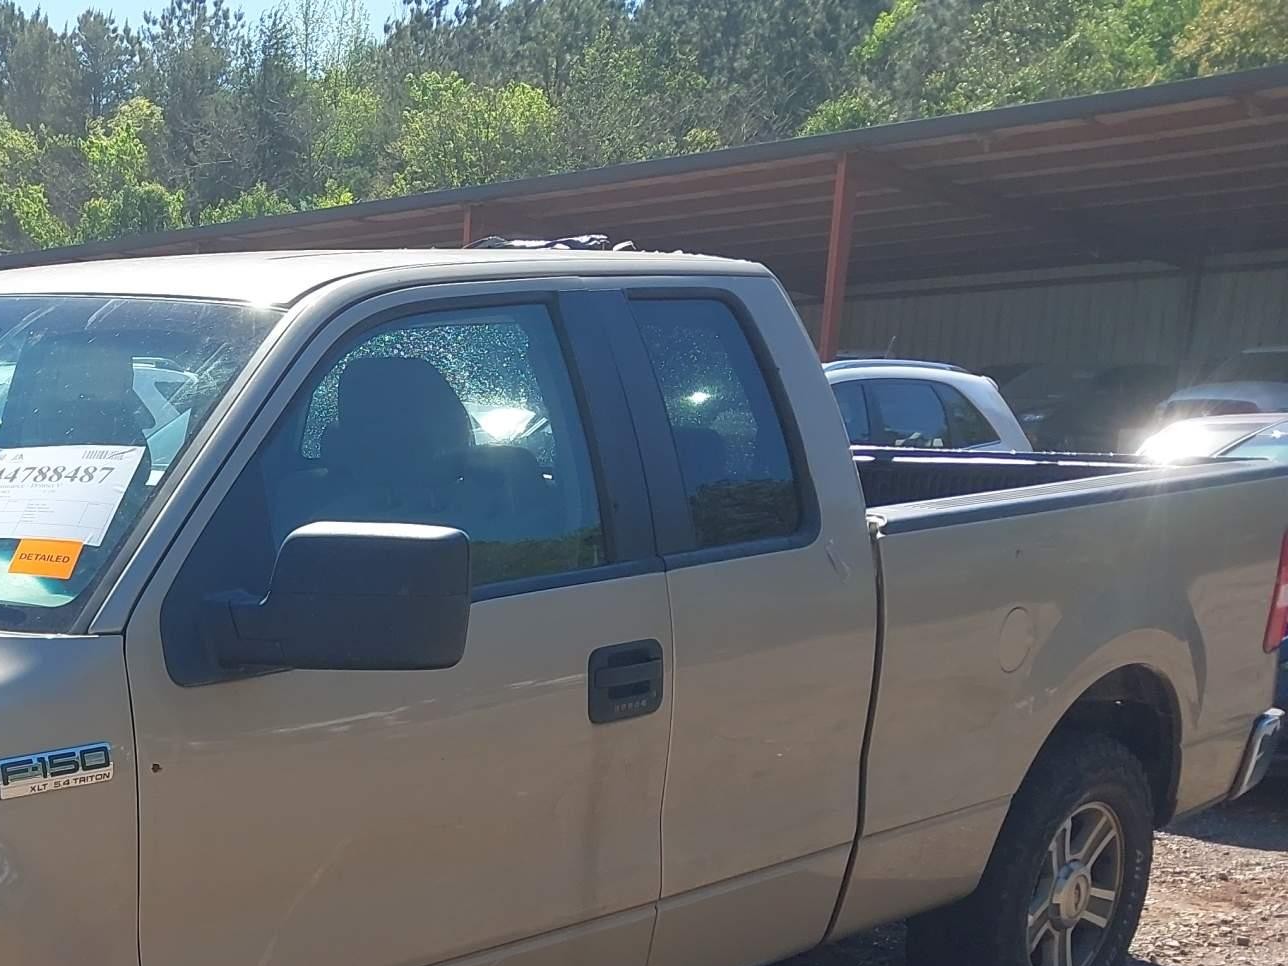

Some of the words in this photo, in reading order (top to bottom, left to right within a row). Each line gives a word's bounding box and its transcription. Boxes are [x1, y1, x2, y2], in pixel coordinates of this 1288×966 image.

[18, 552, 70, 563] DETAILED
[0, 746, 110, 786] F-150
[30, 783, 48, 793] XLT
[72, 772, 110, 785] TRITON
